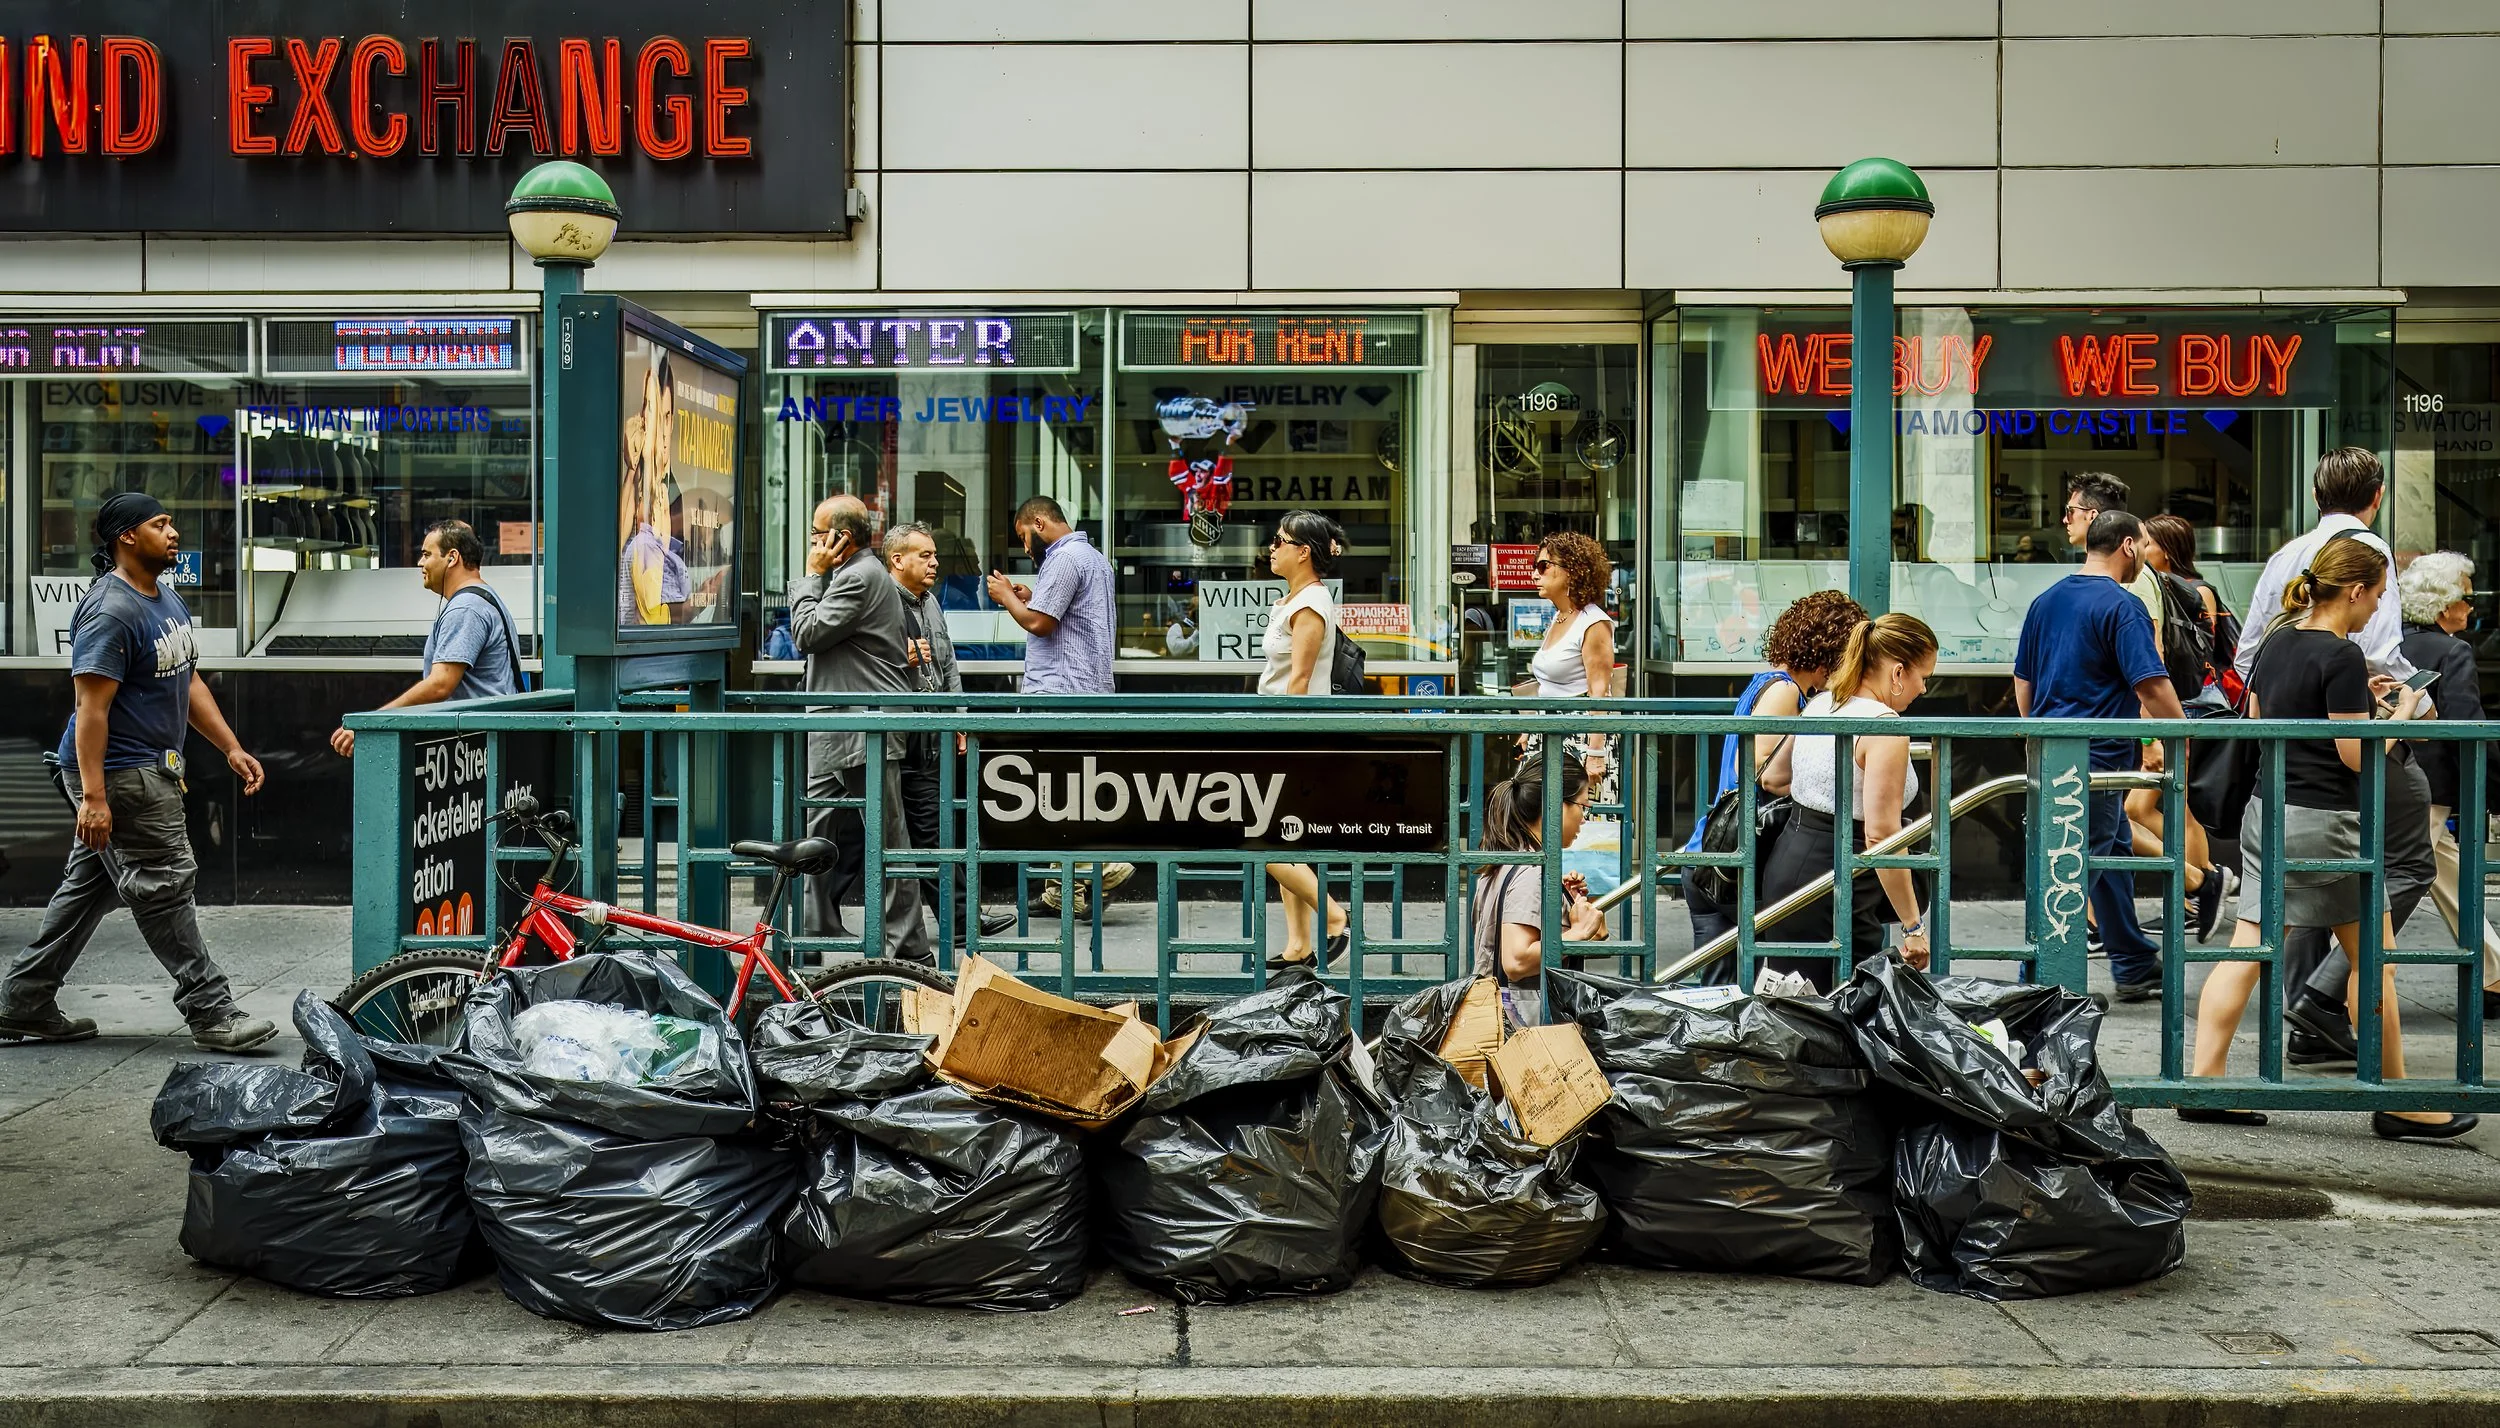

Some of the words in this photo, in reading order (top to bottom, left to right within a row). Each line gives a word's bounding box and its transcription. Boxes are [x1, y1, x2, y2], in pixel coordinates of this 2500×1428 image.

[228, 34, 753, 161] EXCHANGE
[787, 319, 1015, 366] ANTER
[1183, 319, 1255, 362] FOR
[1277, 319, 1369, 362] RENT
[1759, 333, 1853, 396] WE
[2059, 333, 2160, 397] WE
[2180, 333, 2303, 397] BUY
[46, 382, 203, 406] EXCLUSIVE
[235, 382, 299, 406] TIME
[1215, 385, 1348, 406] JEWELRY
[1519, 393, 1558, 411] 1196
[2403, 394, 2444, 413] 1196
[248, 405, 352, 433] FELDMAN
[363, 406, 492, 432] IMPORTERS
[777, 397, 903, 422] ANTER
[915, 396, 1093, 423] JEWELRY
[1895, 409, 2037, 436] IAMOND
[2049, 409, 2189, 436] CASTLE
[2414, 411, 2492, 433] WATCH
[2434, 440, 2493, 452] HAND
[176, 554, 191, 563] UY
[174, 573, 197, 583] NDS
[35, 583, 85, 603] WIN
[1246, 613, 1270, 628] FO
[1217, 633, 1267, 660] RE
[982, 753, 1286, 838] Subway
[1308, 822, 1333, 834] New
[1338, 822, 1363, 834] York
[1368, 822, 1391, 836] City
[1396, 822, 1433, 834] Transit
